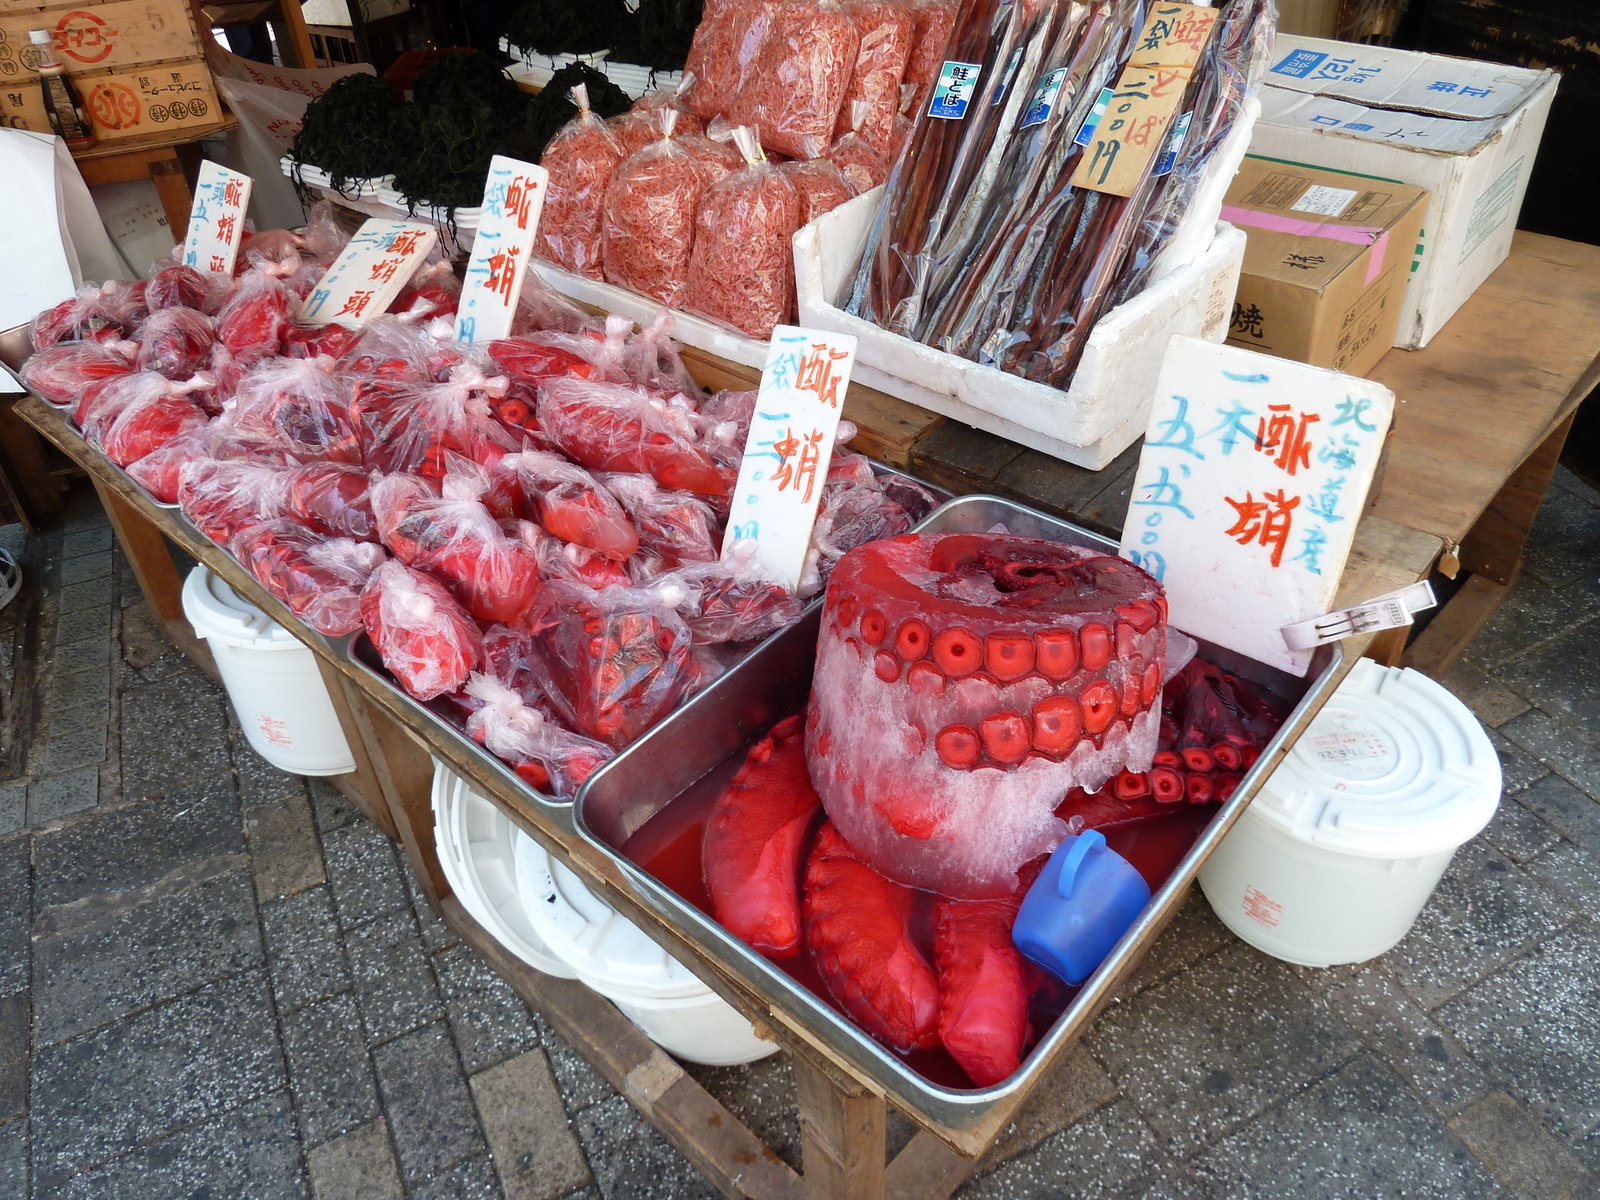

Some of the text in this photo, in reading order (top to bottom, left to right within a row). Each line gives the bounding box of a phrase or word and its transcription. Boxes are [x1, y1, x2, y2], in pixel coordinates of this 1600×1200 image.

[1136, 7, 1182, 52] 一袋
[942, 65, 970, 107] 鮭とば
[1124, 10, 1214, 148] 鮭とば
[480, 169, 512, 220] 一袋
[762, 336, 808, 392] 一袋
[1197, 369, 1274, 457] 一本
[1283, 394, 1378, 576] 北海道産
